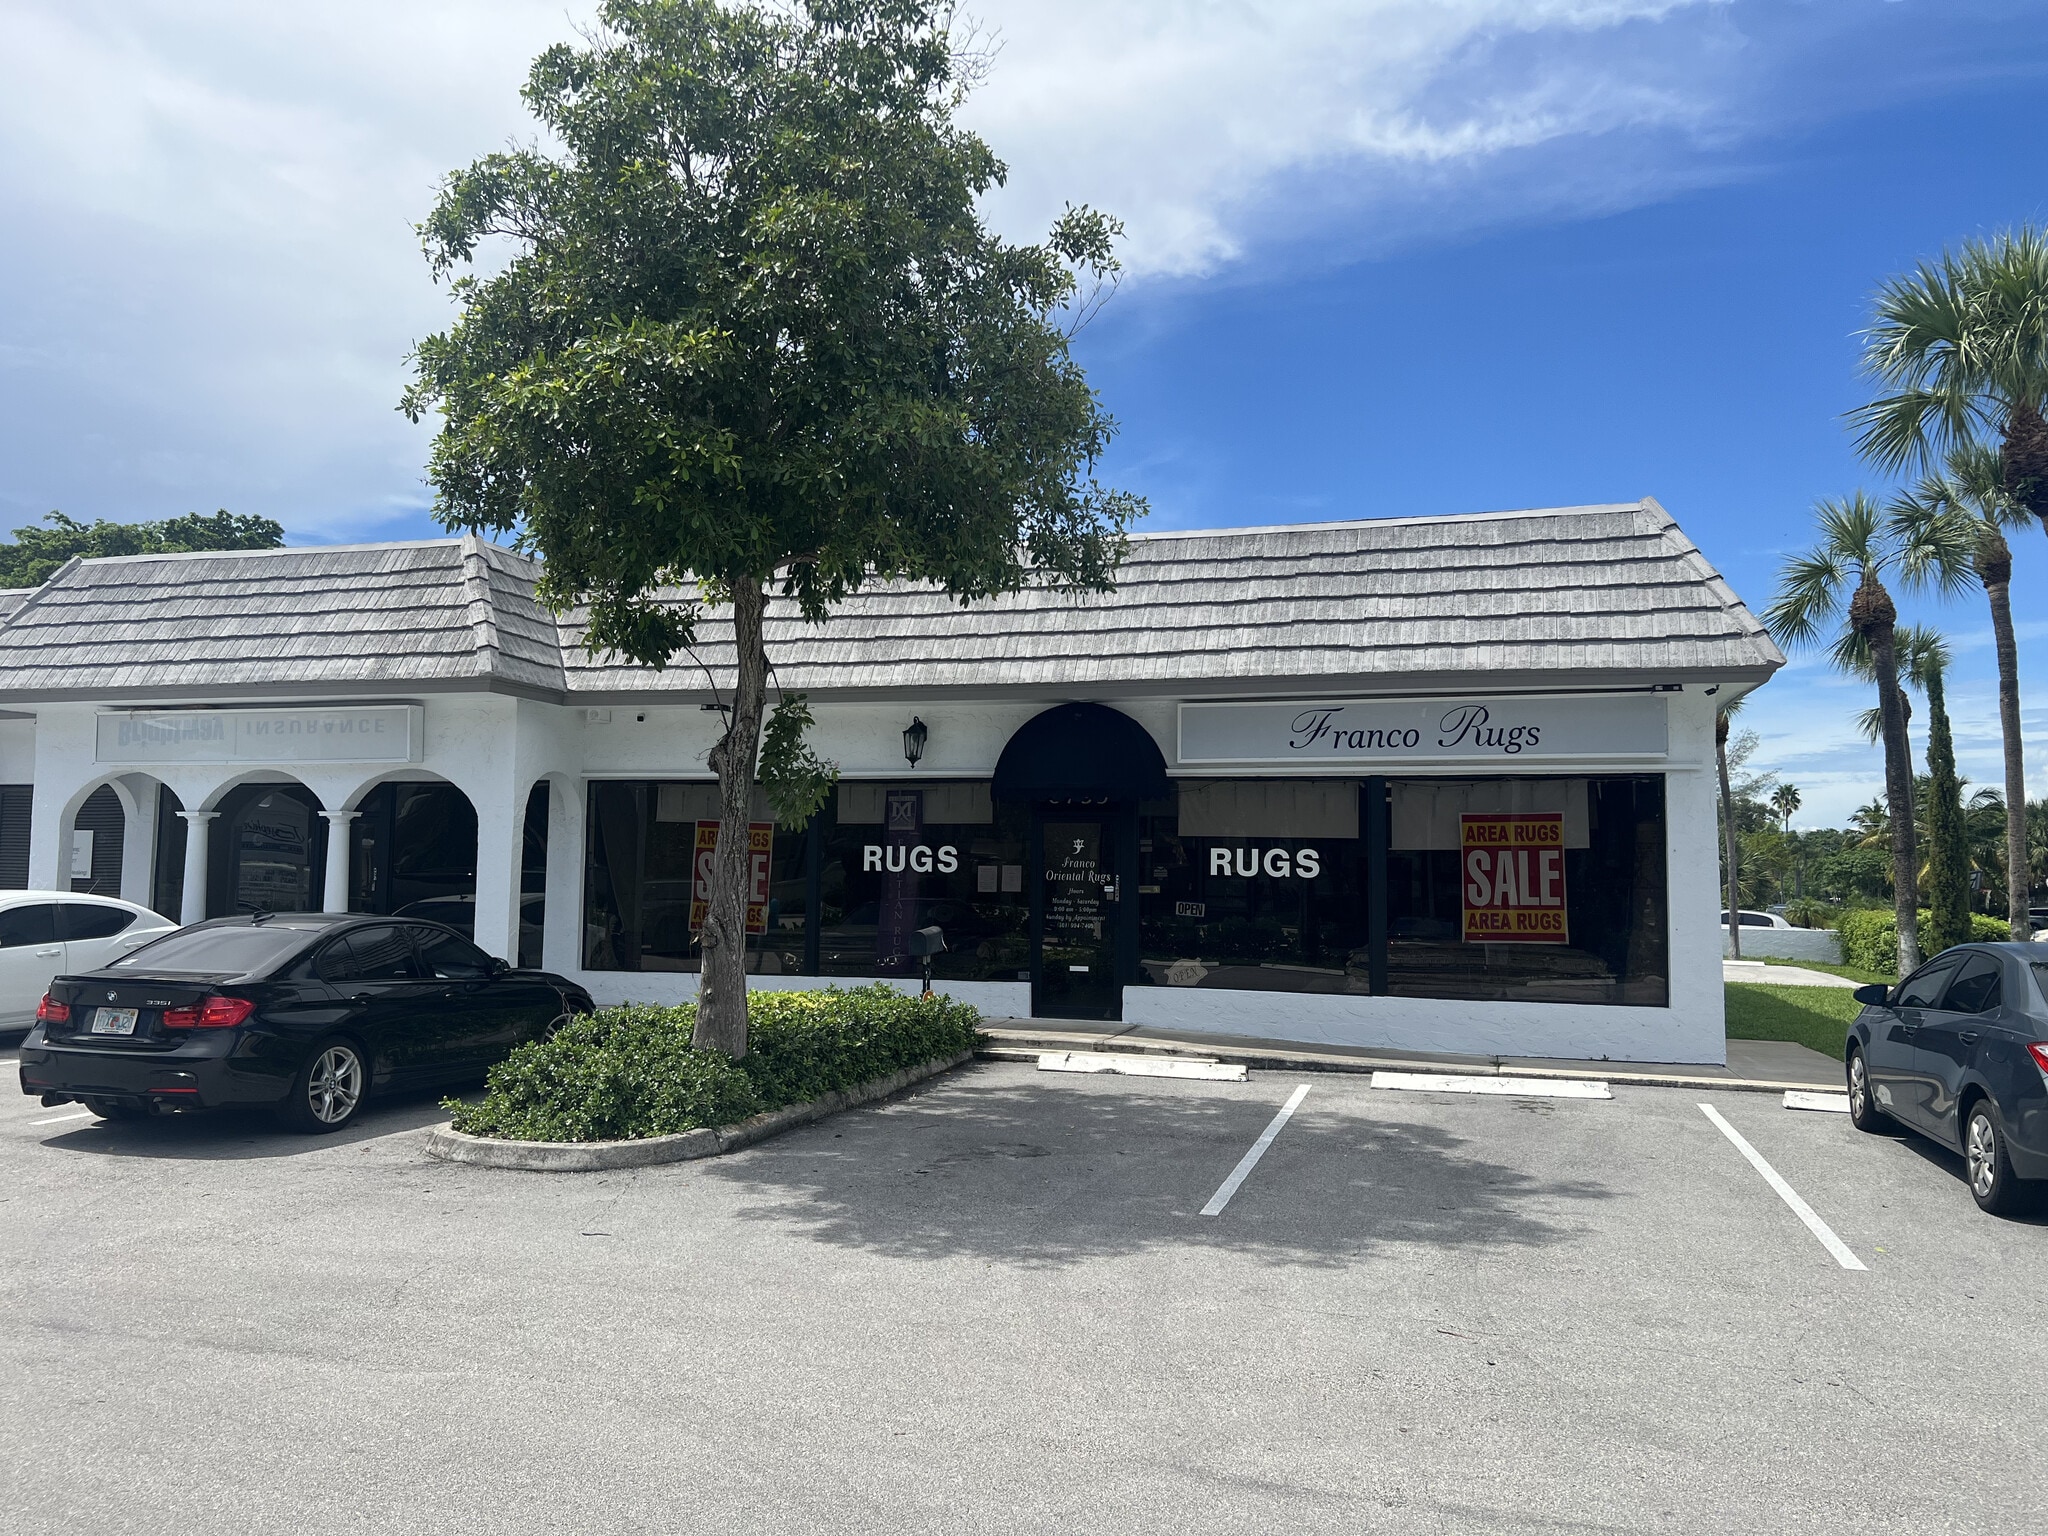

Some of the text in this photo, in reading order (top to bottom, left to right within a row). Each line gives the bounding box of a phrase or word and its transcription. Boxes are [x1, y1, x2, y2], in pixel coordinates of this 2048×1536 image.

[1289, 704, 1541, 754] Franco Rugs
[1465, 824, 1560, 842] AREA RUGS
[863, 844, 959, 874] RUGS
[1061, 856, 1096, 869] Franco
[1209, 847, 1321, 879] RUGS
[696, 851, 768, 903] SE
[1045, 869, 1111, 886] Oriental Rugs
[1467, 849, 1561, 907] SALE
[1177, 902, 1203, 916] OPEN
[1467, 912, 1563, 931] AREA RUGS
[1172, 966, 1199, 984] OPEN
